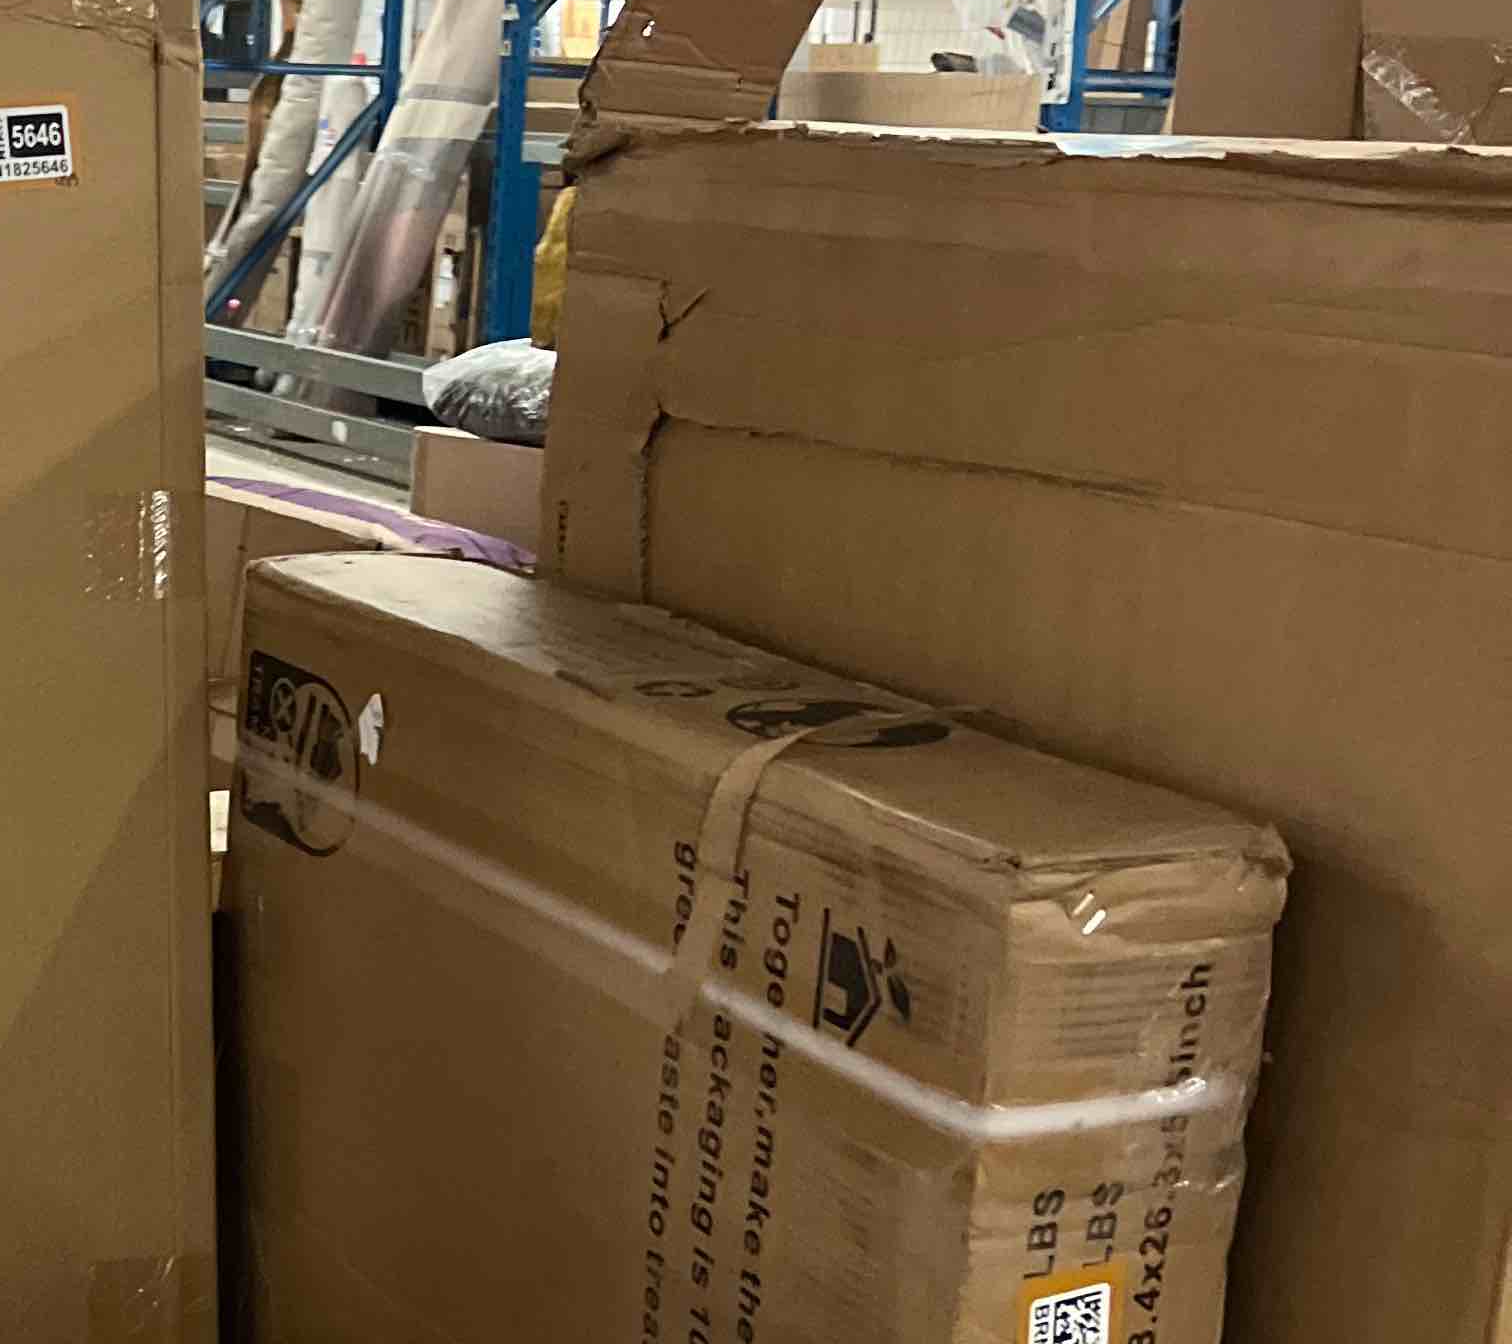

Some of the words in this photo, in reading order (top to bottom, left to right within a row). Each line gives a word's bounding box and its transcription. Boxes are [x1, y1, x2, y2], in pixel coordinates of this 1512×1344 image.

[11, 121, 62, 150] 5646
[719, 867, 750, 970] This
[657, 1017, 683, 1136] aste
[690, 1006, 733, 1237] ackaging
[648, 1145, 675, 1237] into
[1023, 1189, 1065, 1281] LBS
[1081, 1182, 1125, 1268] LBS
[690, 1245, 716, 1289] is
[737, 1268, 762, 1344] the
